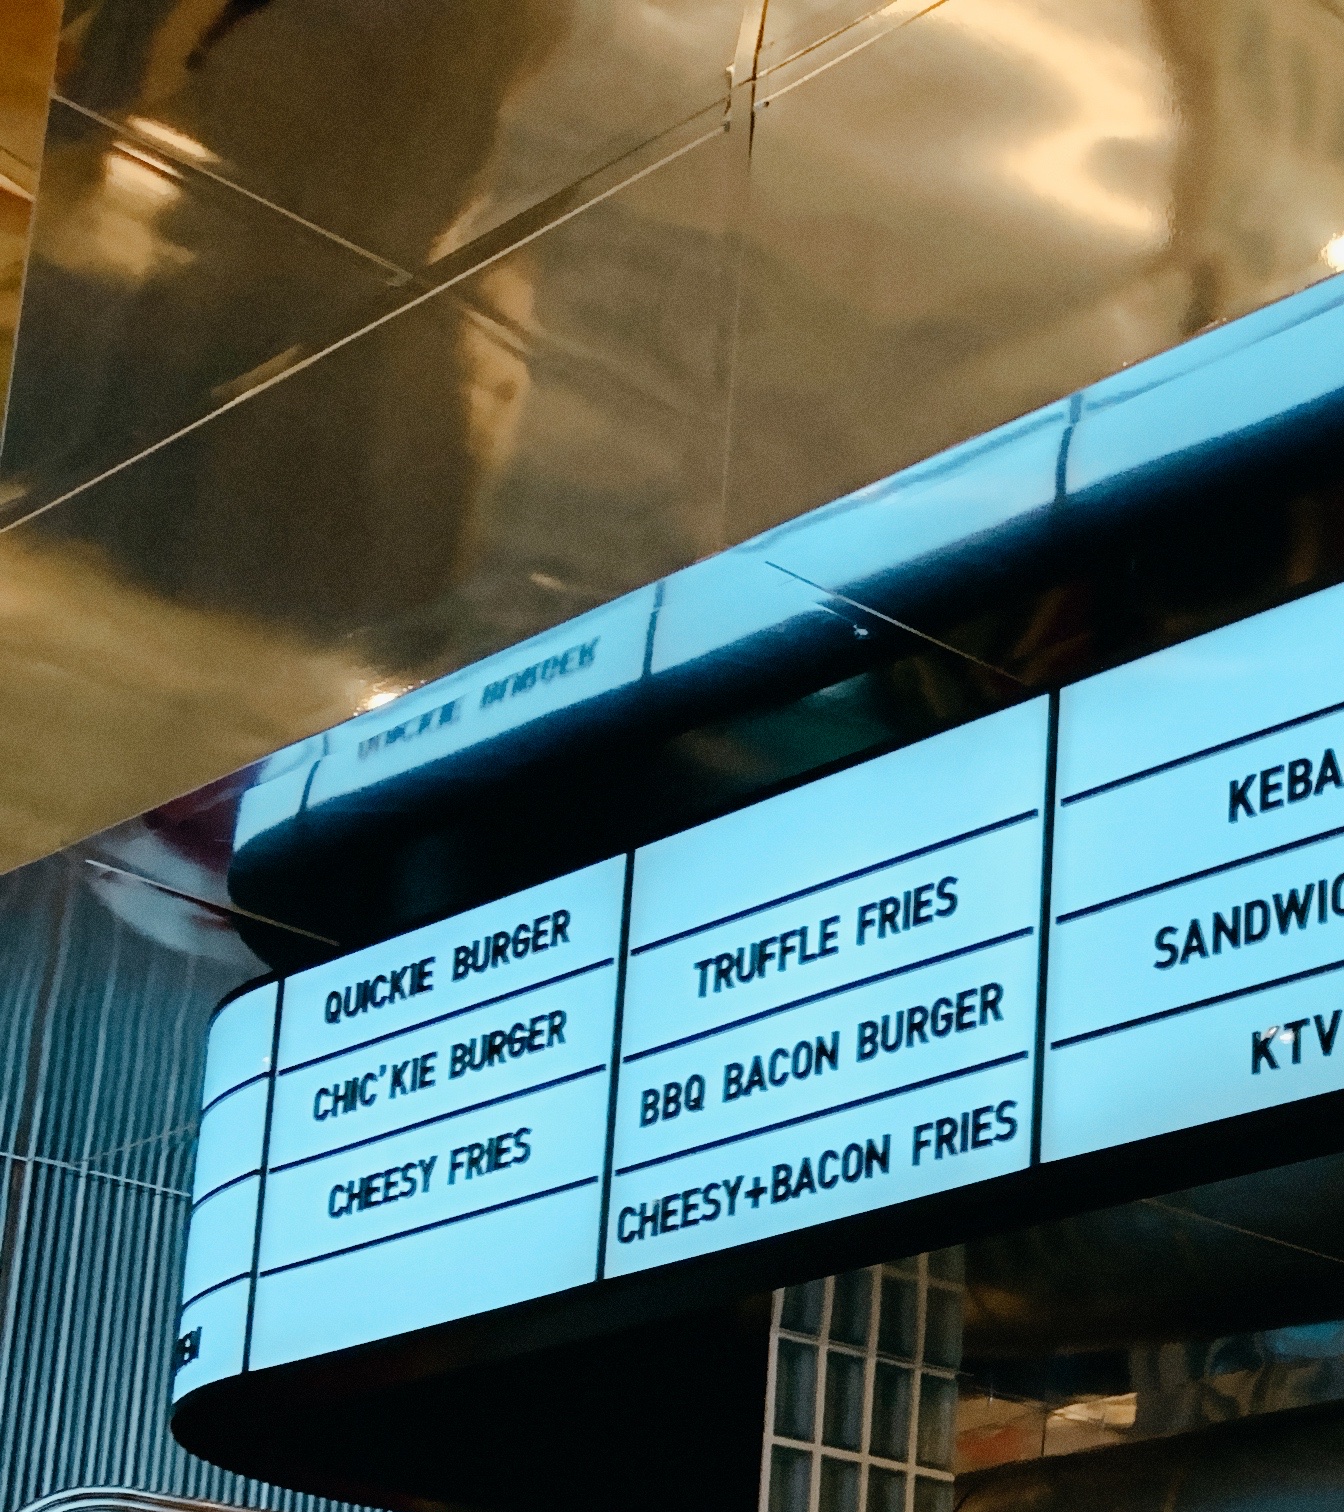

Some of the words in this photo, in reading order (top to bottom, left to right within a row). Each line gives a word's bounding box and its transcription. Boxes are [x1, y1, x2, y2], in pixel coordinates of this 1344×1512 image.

[323, 958, 435, 1024] QUICKIE
[453, 910, 572, 982] BURGER
[694, 926, 841, 997] TRUFFLE
[857, 876, 960, 947] FRIES
[451, 1010, 567, 1081] BURGER
[640, 1075, 706, 1128] BBQ
[725, 1031, 841, 1103] BACON
[857, 983, 1006, 1062] BURGER
[1251, 1009, 1343, 1075] KTV
[328, 1156, 437, 1218] CHEESY
[448, 1129, 533, 1188] FRIES
[616, 1134, 891, 1244] CHEESY+BACON
[912, 1100, 1019, 1168] FRIES
